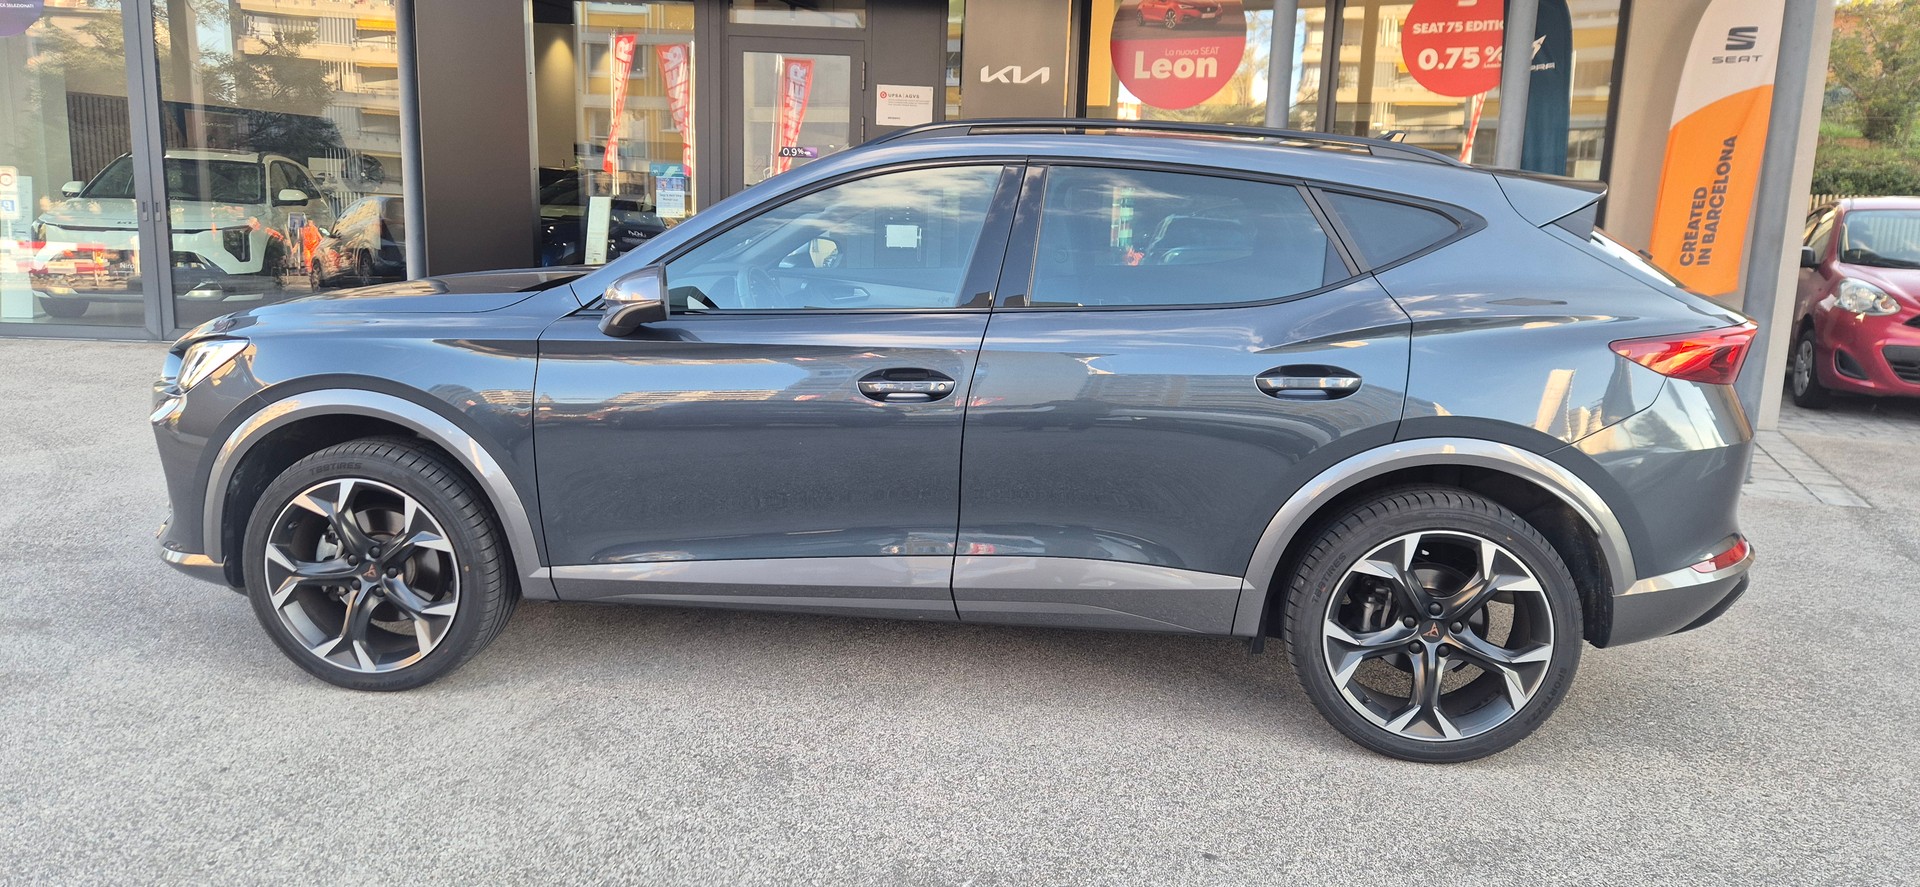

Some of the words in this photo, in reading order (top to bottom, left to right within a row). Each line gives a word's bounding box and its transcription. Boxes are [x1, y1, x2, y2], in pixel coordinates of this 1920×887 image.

[1413, 22, 1445, 34] SEAT
[1446, 21, 1463, 33] 75
[1466, 20, 1504, 32] EDITI
[1201, 46, 1220, 55] SEAT
[1418, 46, 1481, 71] 0.75
[1712, 54, 1763, 64] SEAT
[980, 65, 1050, 85] KIA
[1134, 51, 1218, 79] Leon
[1702, 135, 1738, 244] BARCELONA
[1680, 186, 1708, 267] CREATED
[1697, 248, 1712, 266] IN
